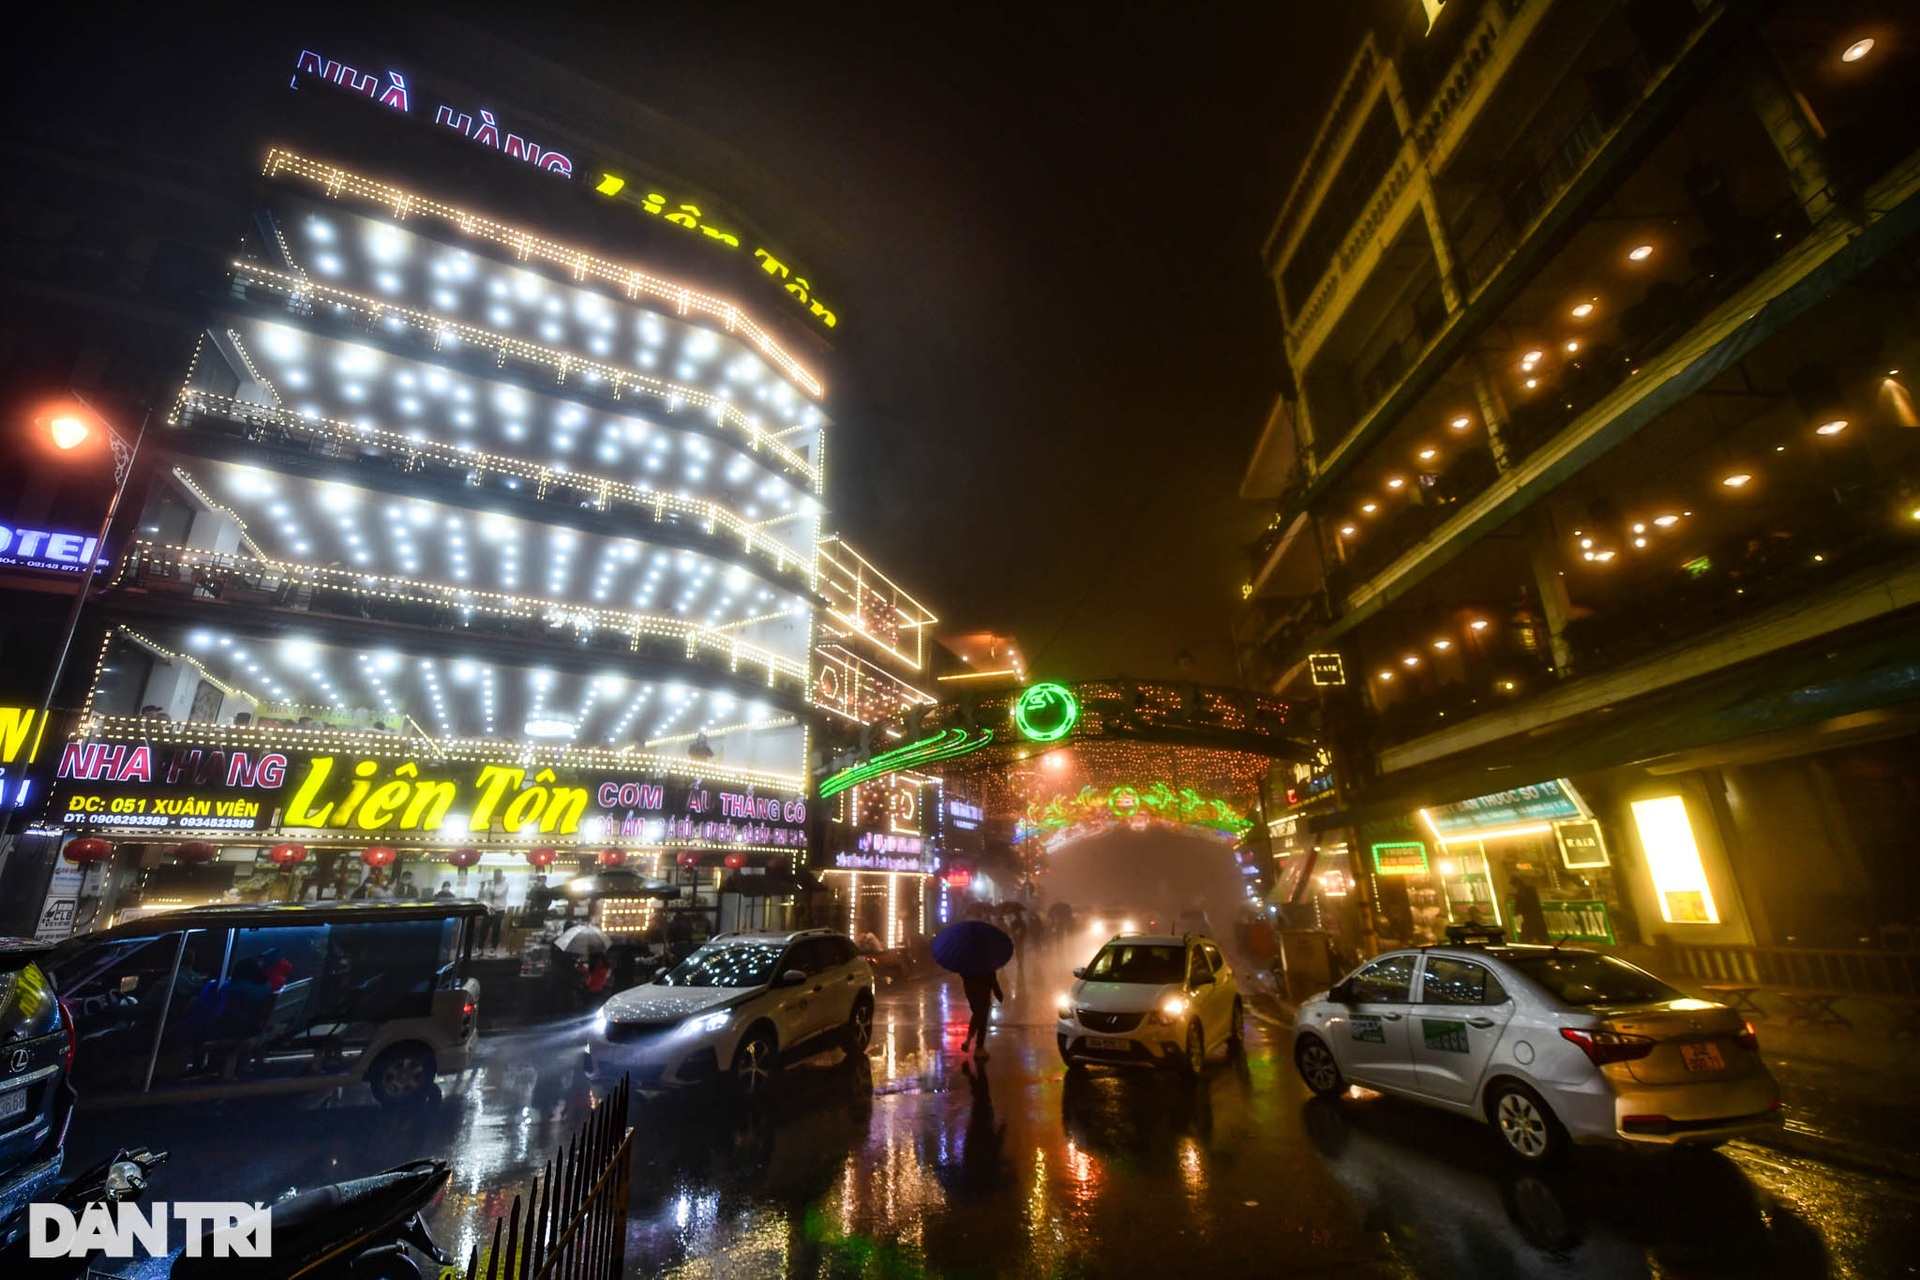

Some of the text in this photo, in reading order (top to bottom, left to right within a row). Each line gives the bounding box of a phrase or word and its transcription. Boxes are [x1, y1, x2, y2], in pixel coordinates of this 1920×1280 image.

[69, 795, 260, 818] ĐC: 051 XUÂN VIÊN
[283, 756, 588, 835] Liên Tôn
[598, 782, 664, 810] CƠM
